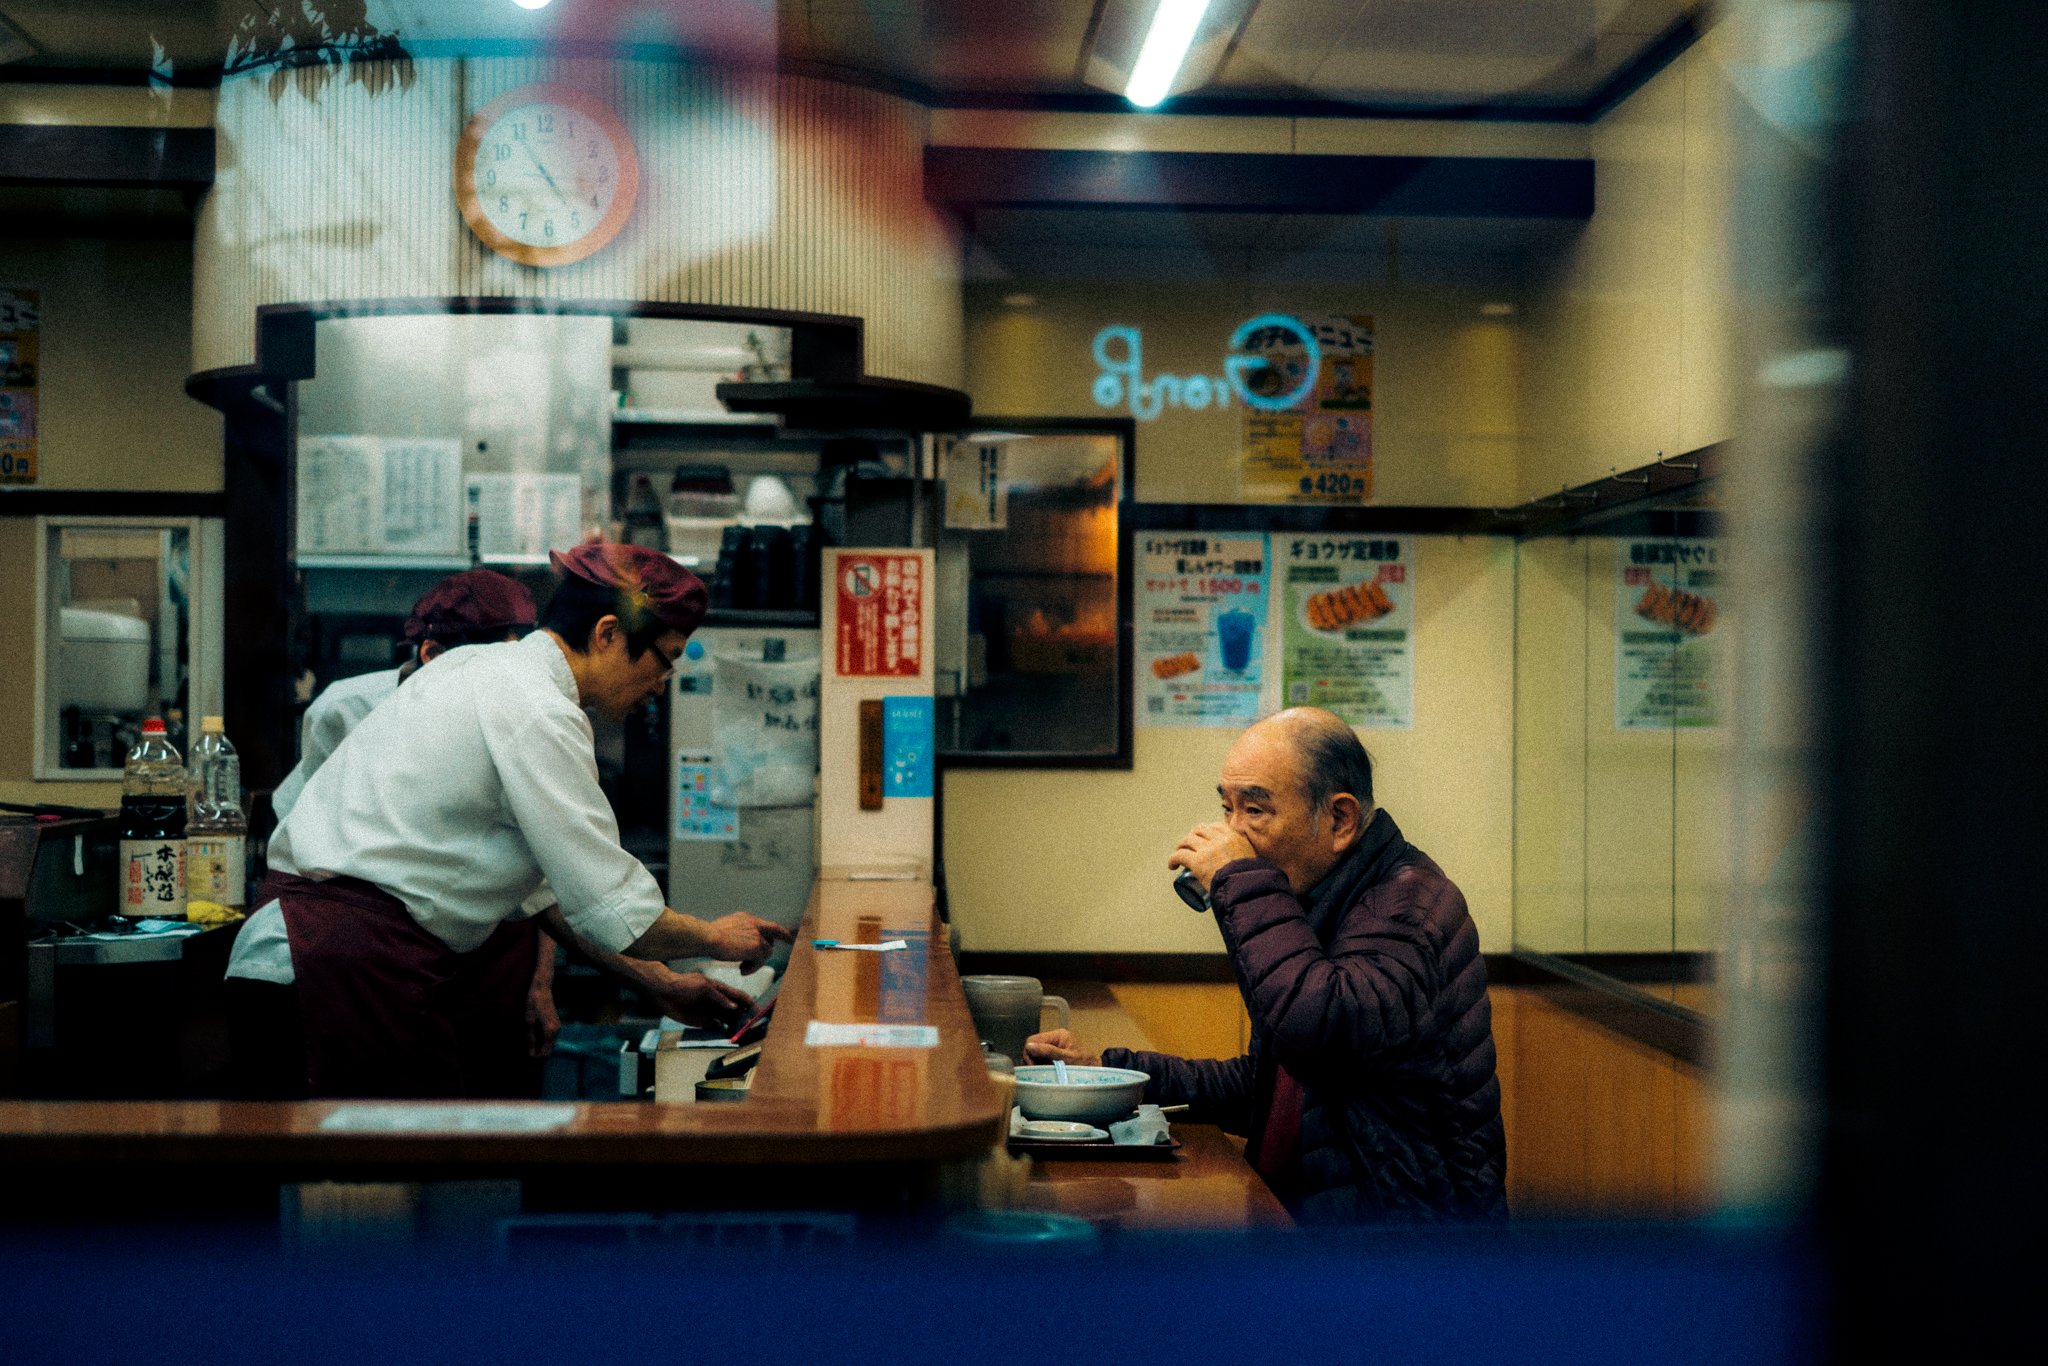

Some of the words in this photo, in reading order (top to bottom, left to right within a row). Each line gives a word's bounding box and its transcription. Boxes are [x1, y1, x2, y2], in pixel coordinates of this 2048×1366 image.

[512, 123, 527, 140] 11
[537, 114, 553, 132] 12
[494, 144, 510, 160] 10
[588, 141, 598, 158] 2
[486, 169, 496, 186] 9
[598, 166, 608, 183] 3
[499, 195, 509, 212] 8
[590, 195, 598, 209] 4
[519, 213, 528, 229] 7
[544, 220, 553, 237] 6
[571, 212, 580, 228] 5
